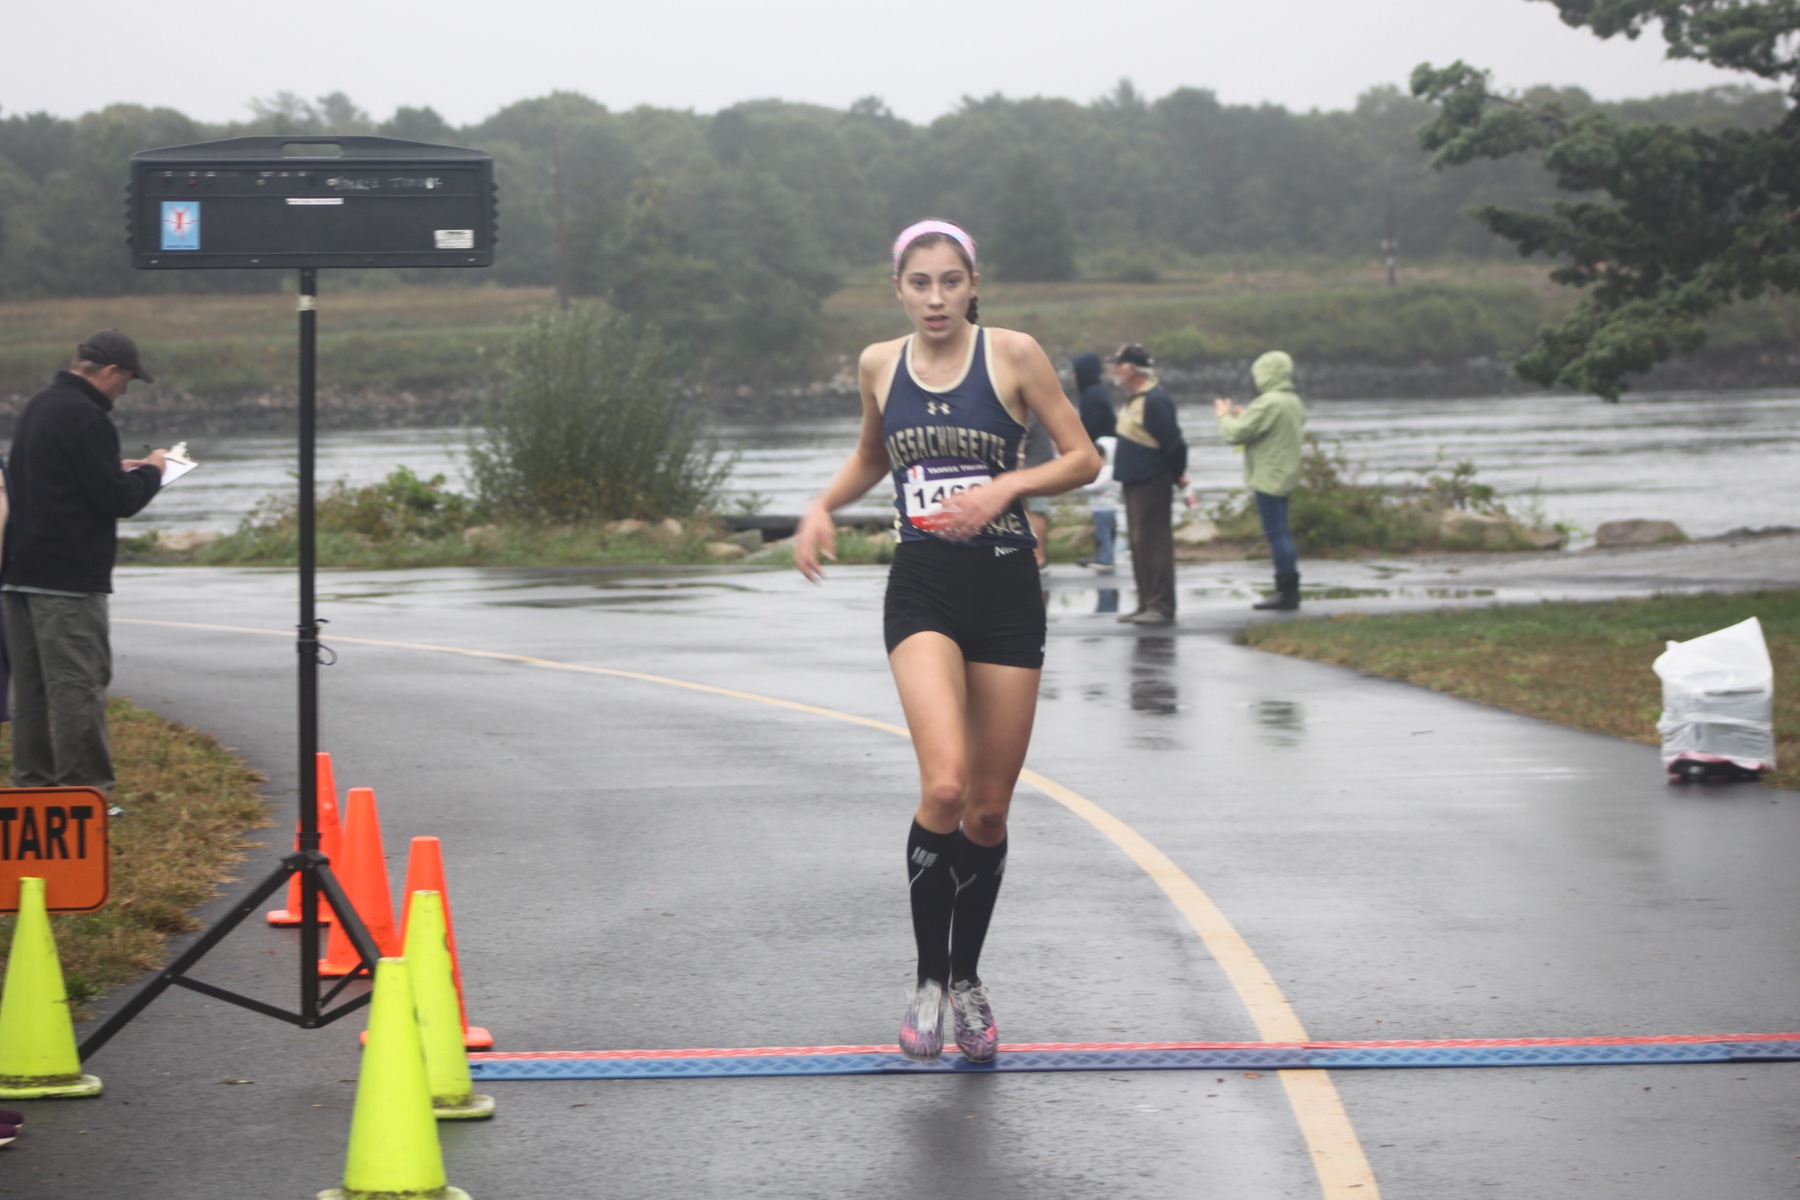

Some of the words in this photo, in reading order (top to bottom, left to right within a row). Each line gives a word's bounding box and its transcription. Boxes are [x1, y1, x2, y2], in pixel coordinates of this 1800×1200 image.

[887, 427, 1006, 470] ASSACHUSETTS
[914, 485, 984, 509] 14
[0, 806, 93, 860] TART
